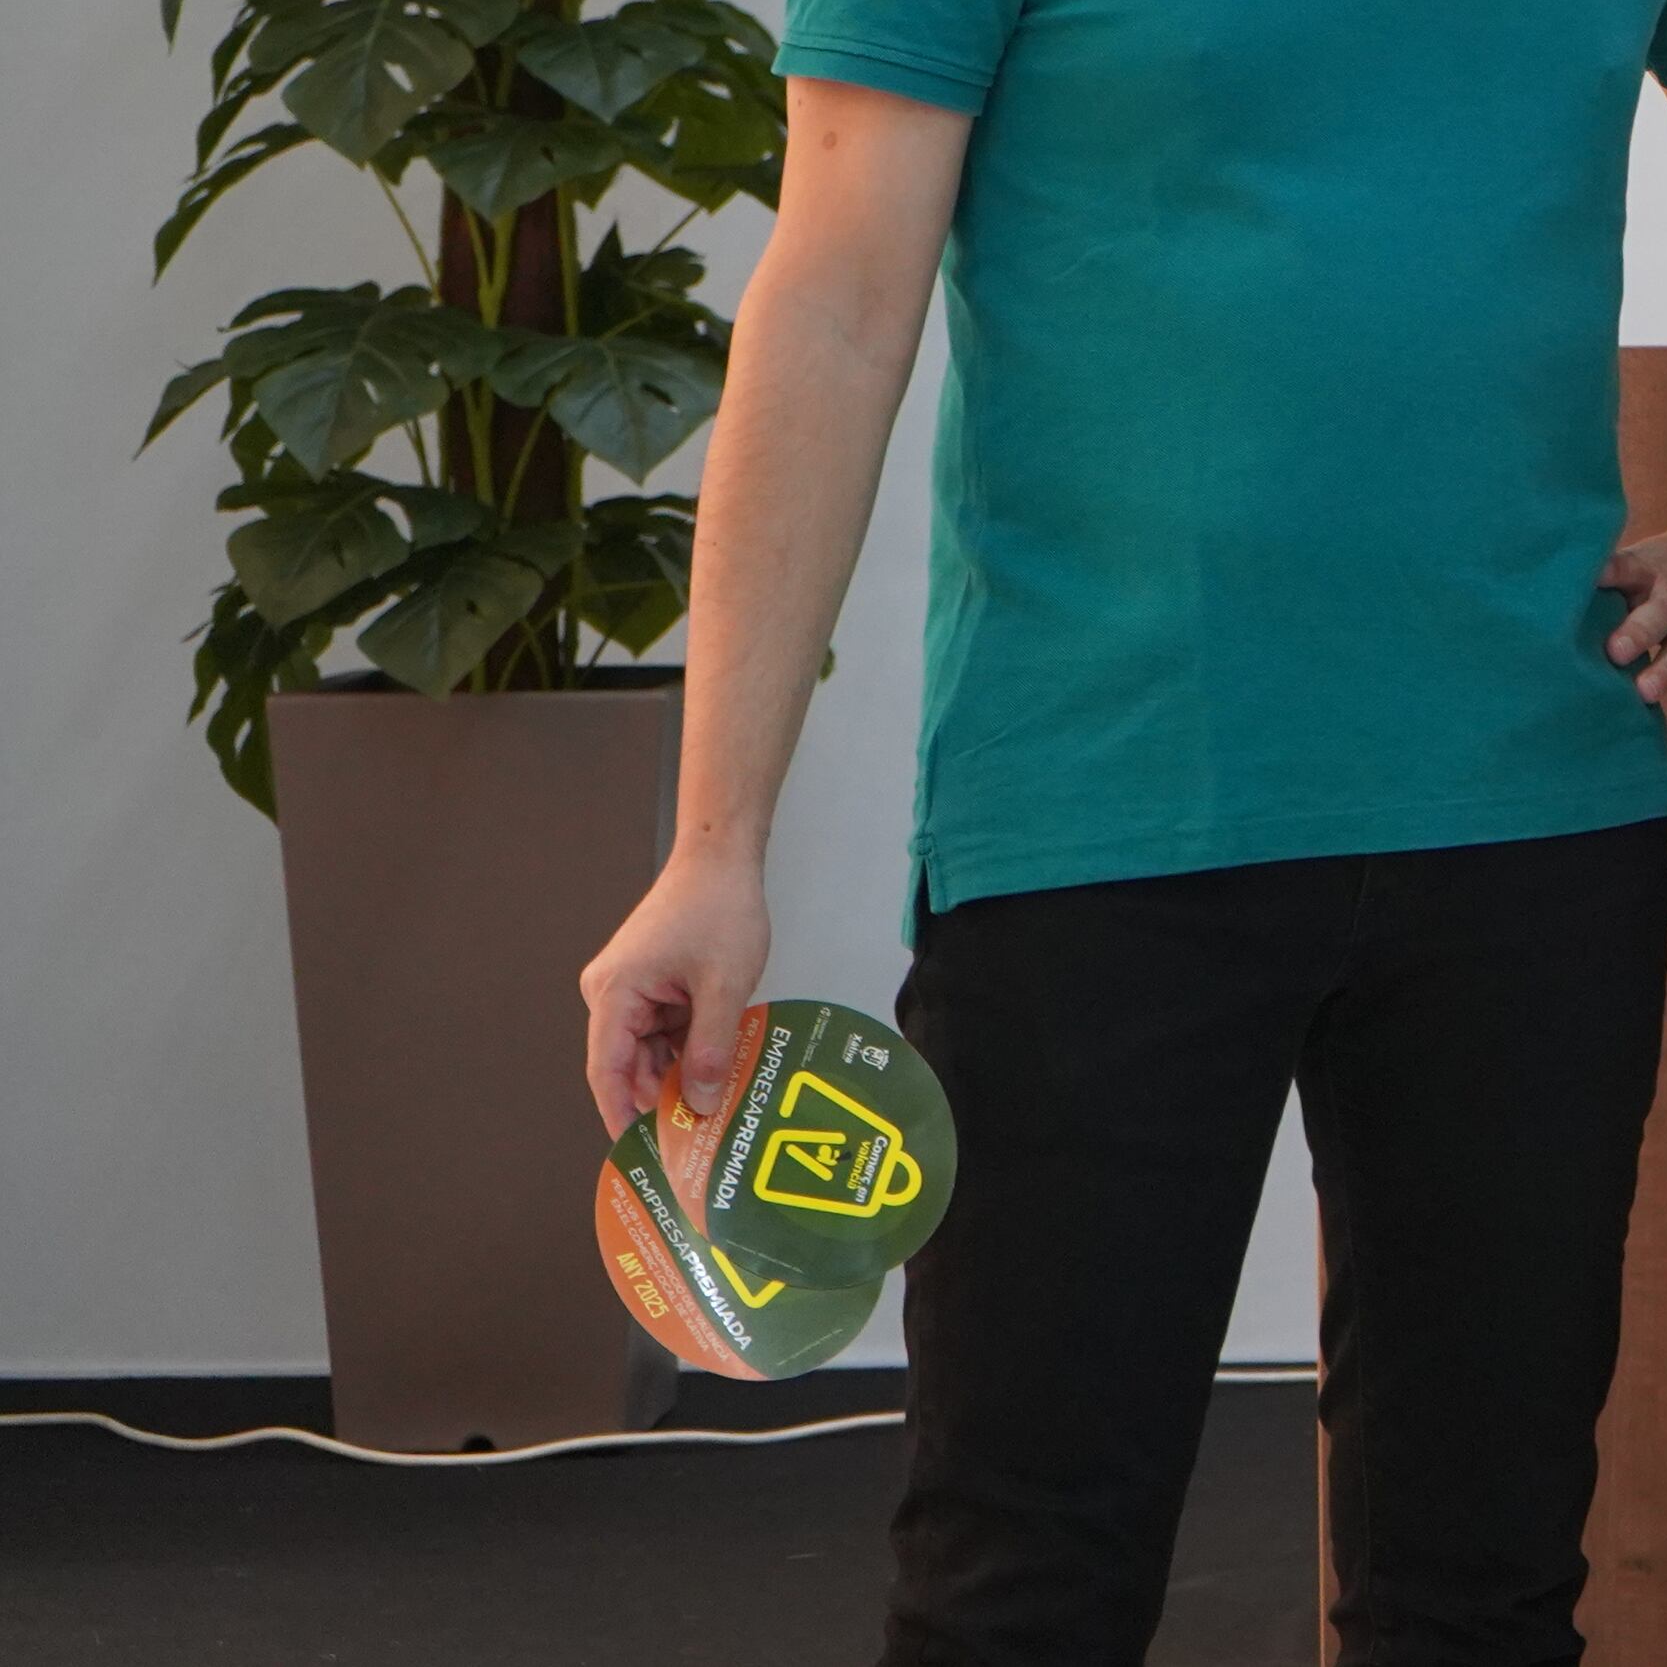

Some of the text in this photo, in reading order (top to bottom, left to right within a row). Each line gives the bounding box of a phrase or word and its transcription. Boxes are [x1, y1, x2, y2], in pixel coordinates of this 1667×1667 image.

[855, 1135, 889, 1204] Comerç en
[615, 1250, 670, 1320] ANY 2025
